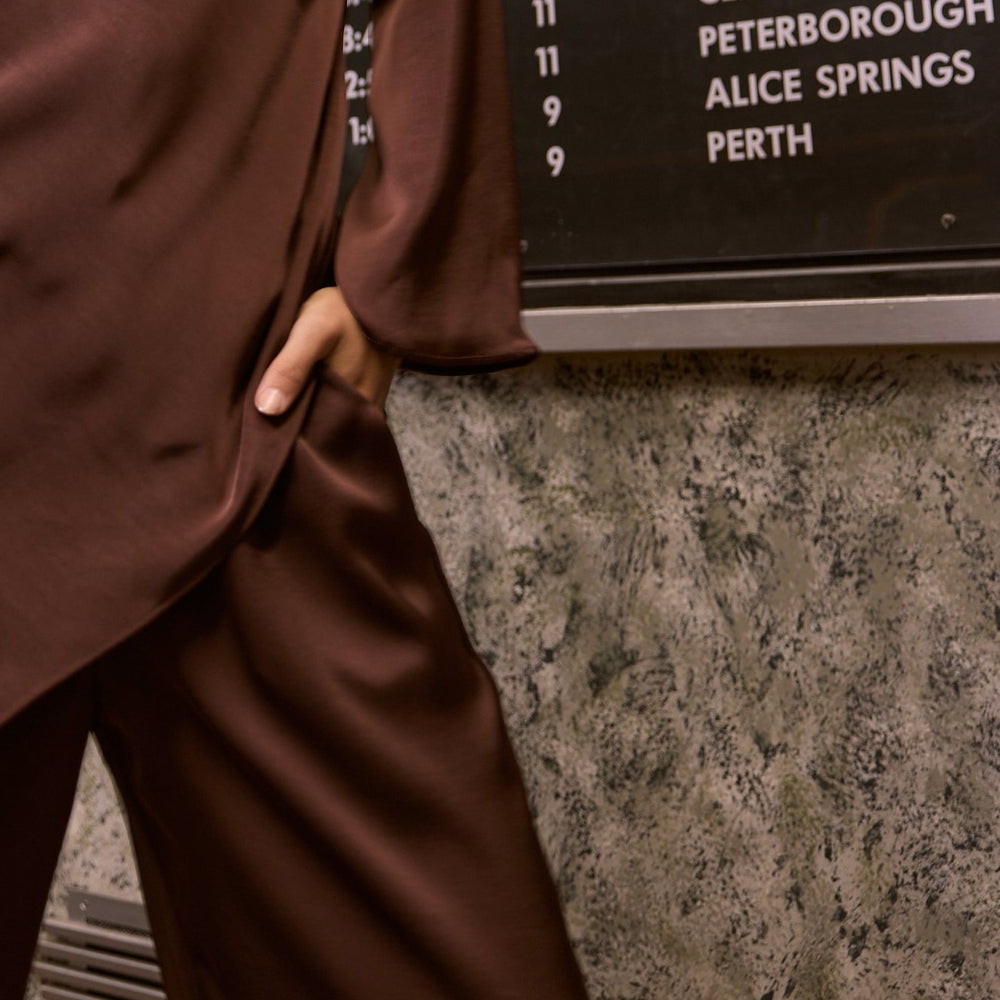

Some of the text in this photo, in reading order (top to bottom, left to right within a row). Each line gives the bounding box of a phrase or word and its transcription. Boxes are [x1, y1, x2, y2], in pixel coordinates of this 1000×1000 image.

[535, 45, 560, 78] 11
[705, 50, 976, 111] ALICE SPRINGS
[543, 95, 562, 128] 9
[707, 122, 815, 164] PERTH
[546, 145, 565, 178] 9
